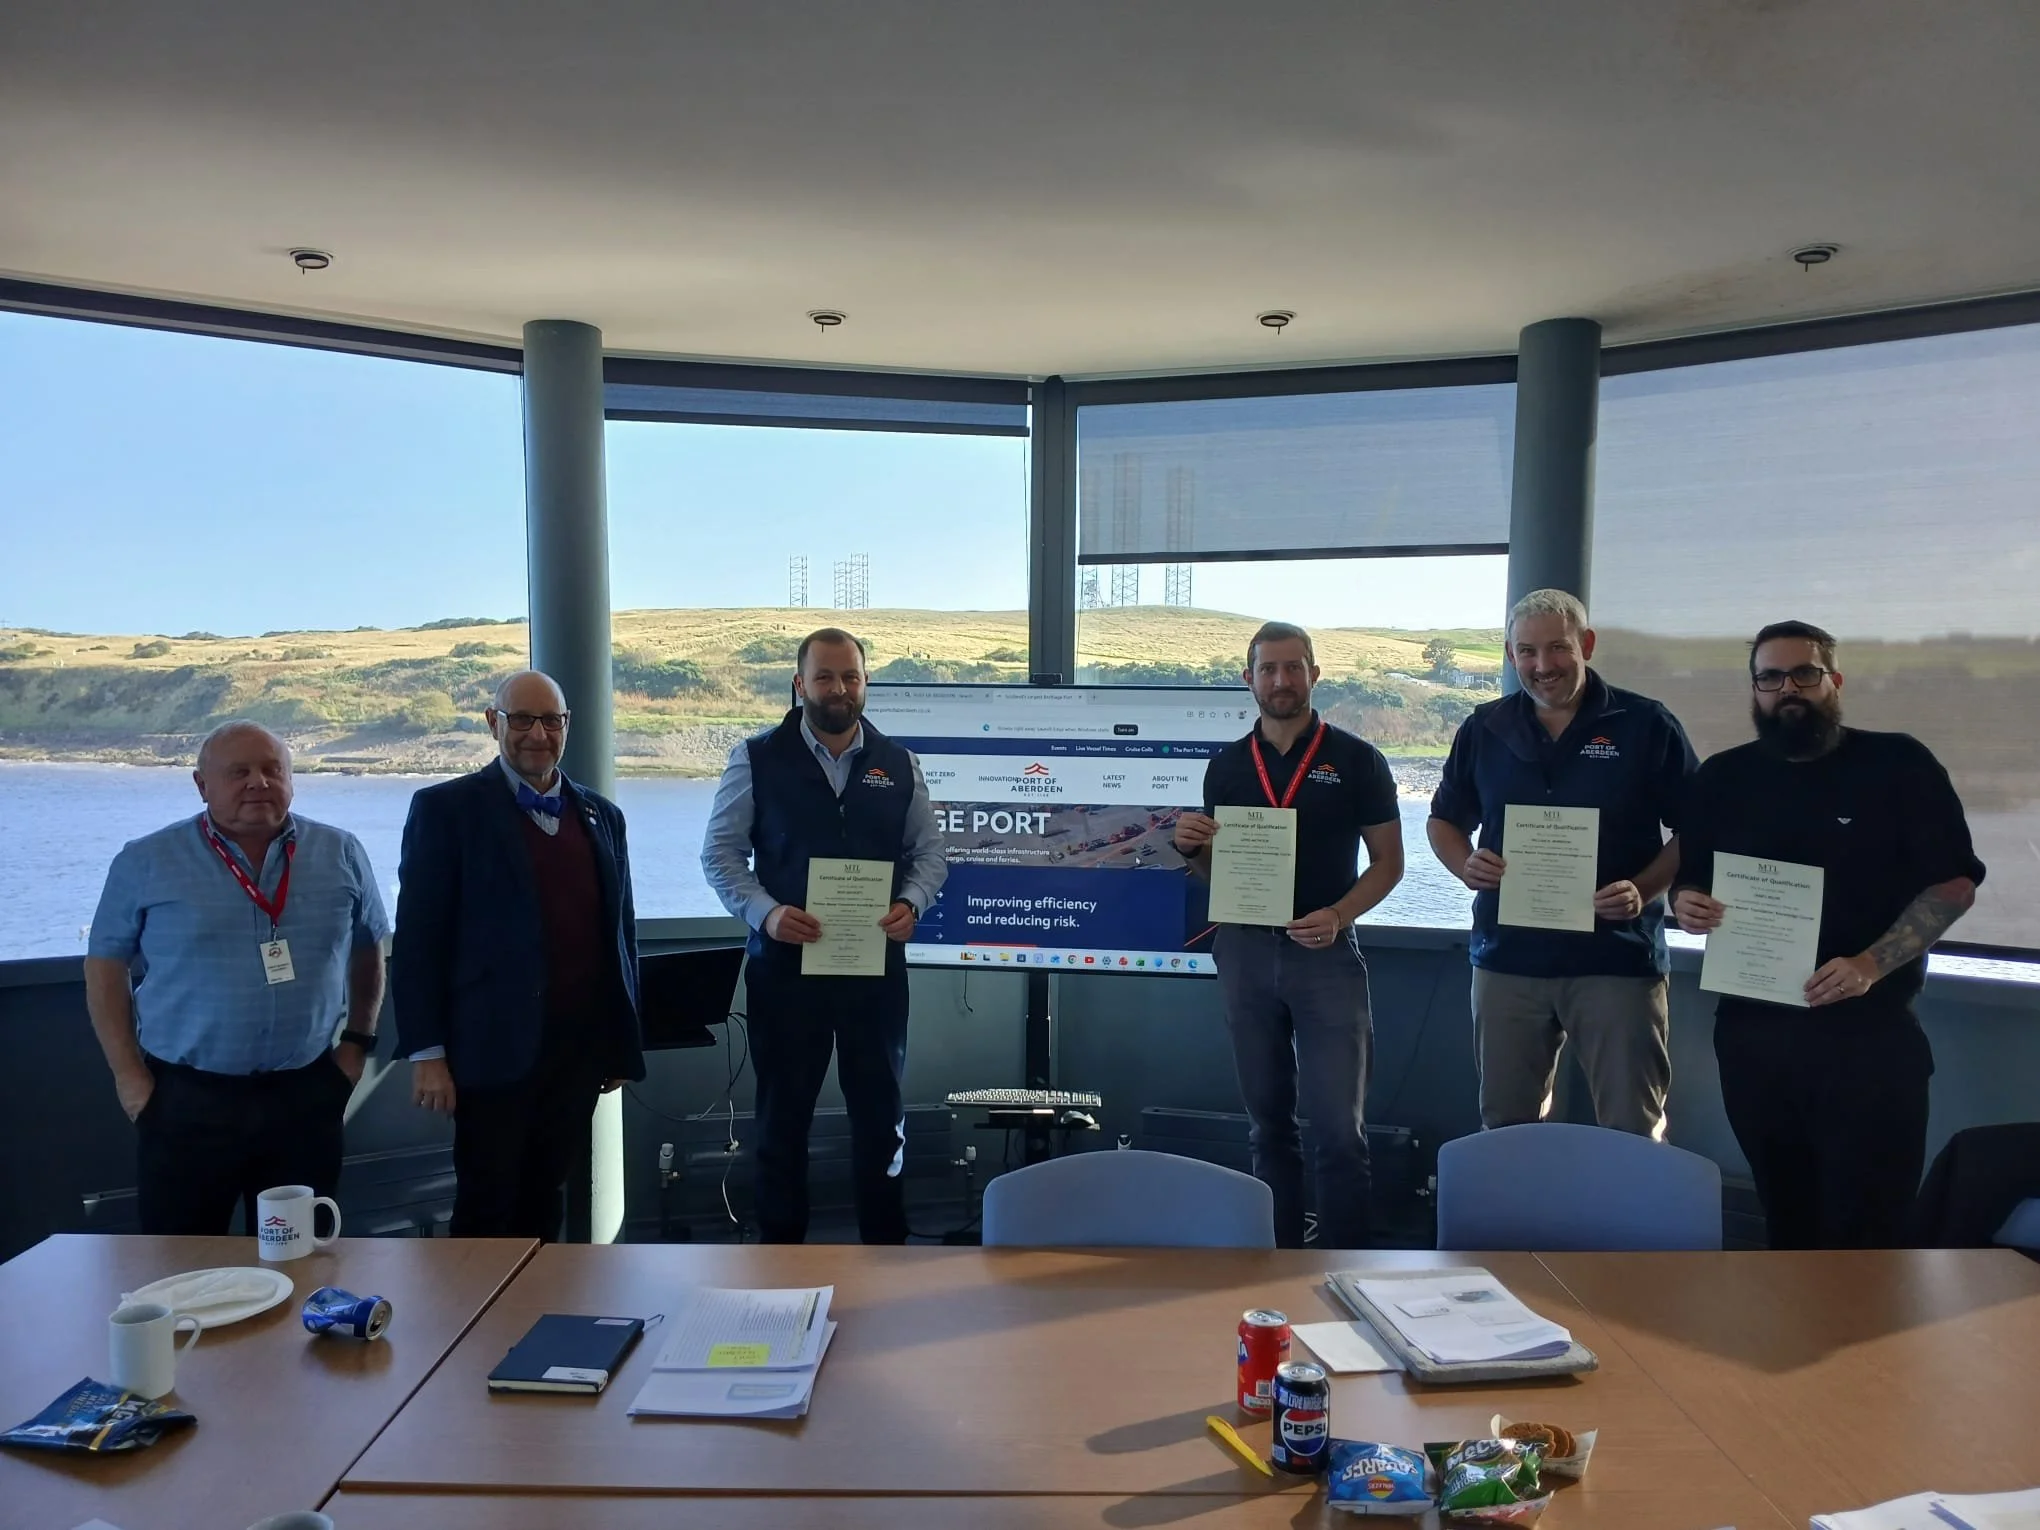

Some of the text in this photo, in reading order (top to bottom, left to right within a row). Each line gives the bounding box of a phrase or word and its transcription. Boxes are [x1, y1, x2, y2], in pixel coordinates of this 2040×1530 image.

[973, 811, 1051, 834] PORT
[945, 846, 970, 854] offering
[1727, 872, 1759, 882] Certificate
[1770, 879, 1810, 889] Qualification
[967, 895, 1097, 913] Improving efficiency
[967, 913, 1080, 930] and reducing risk.
[1284, 1421, 1326, 1436] PEPSI
